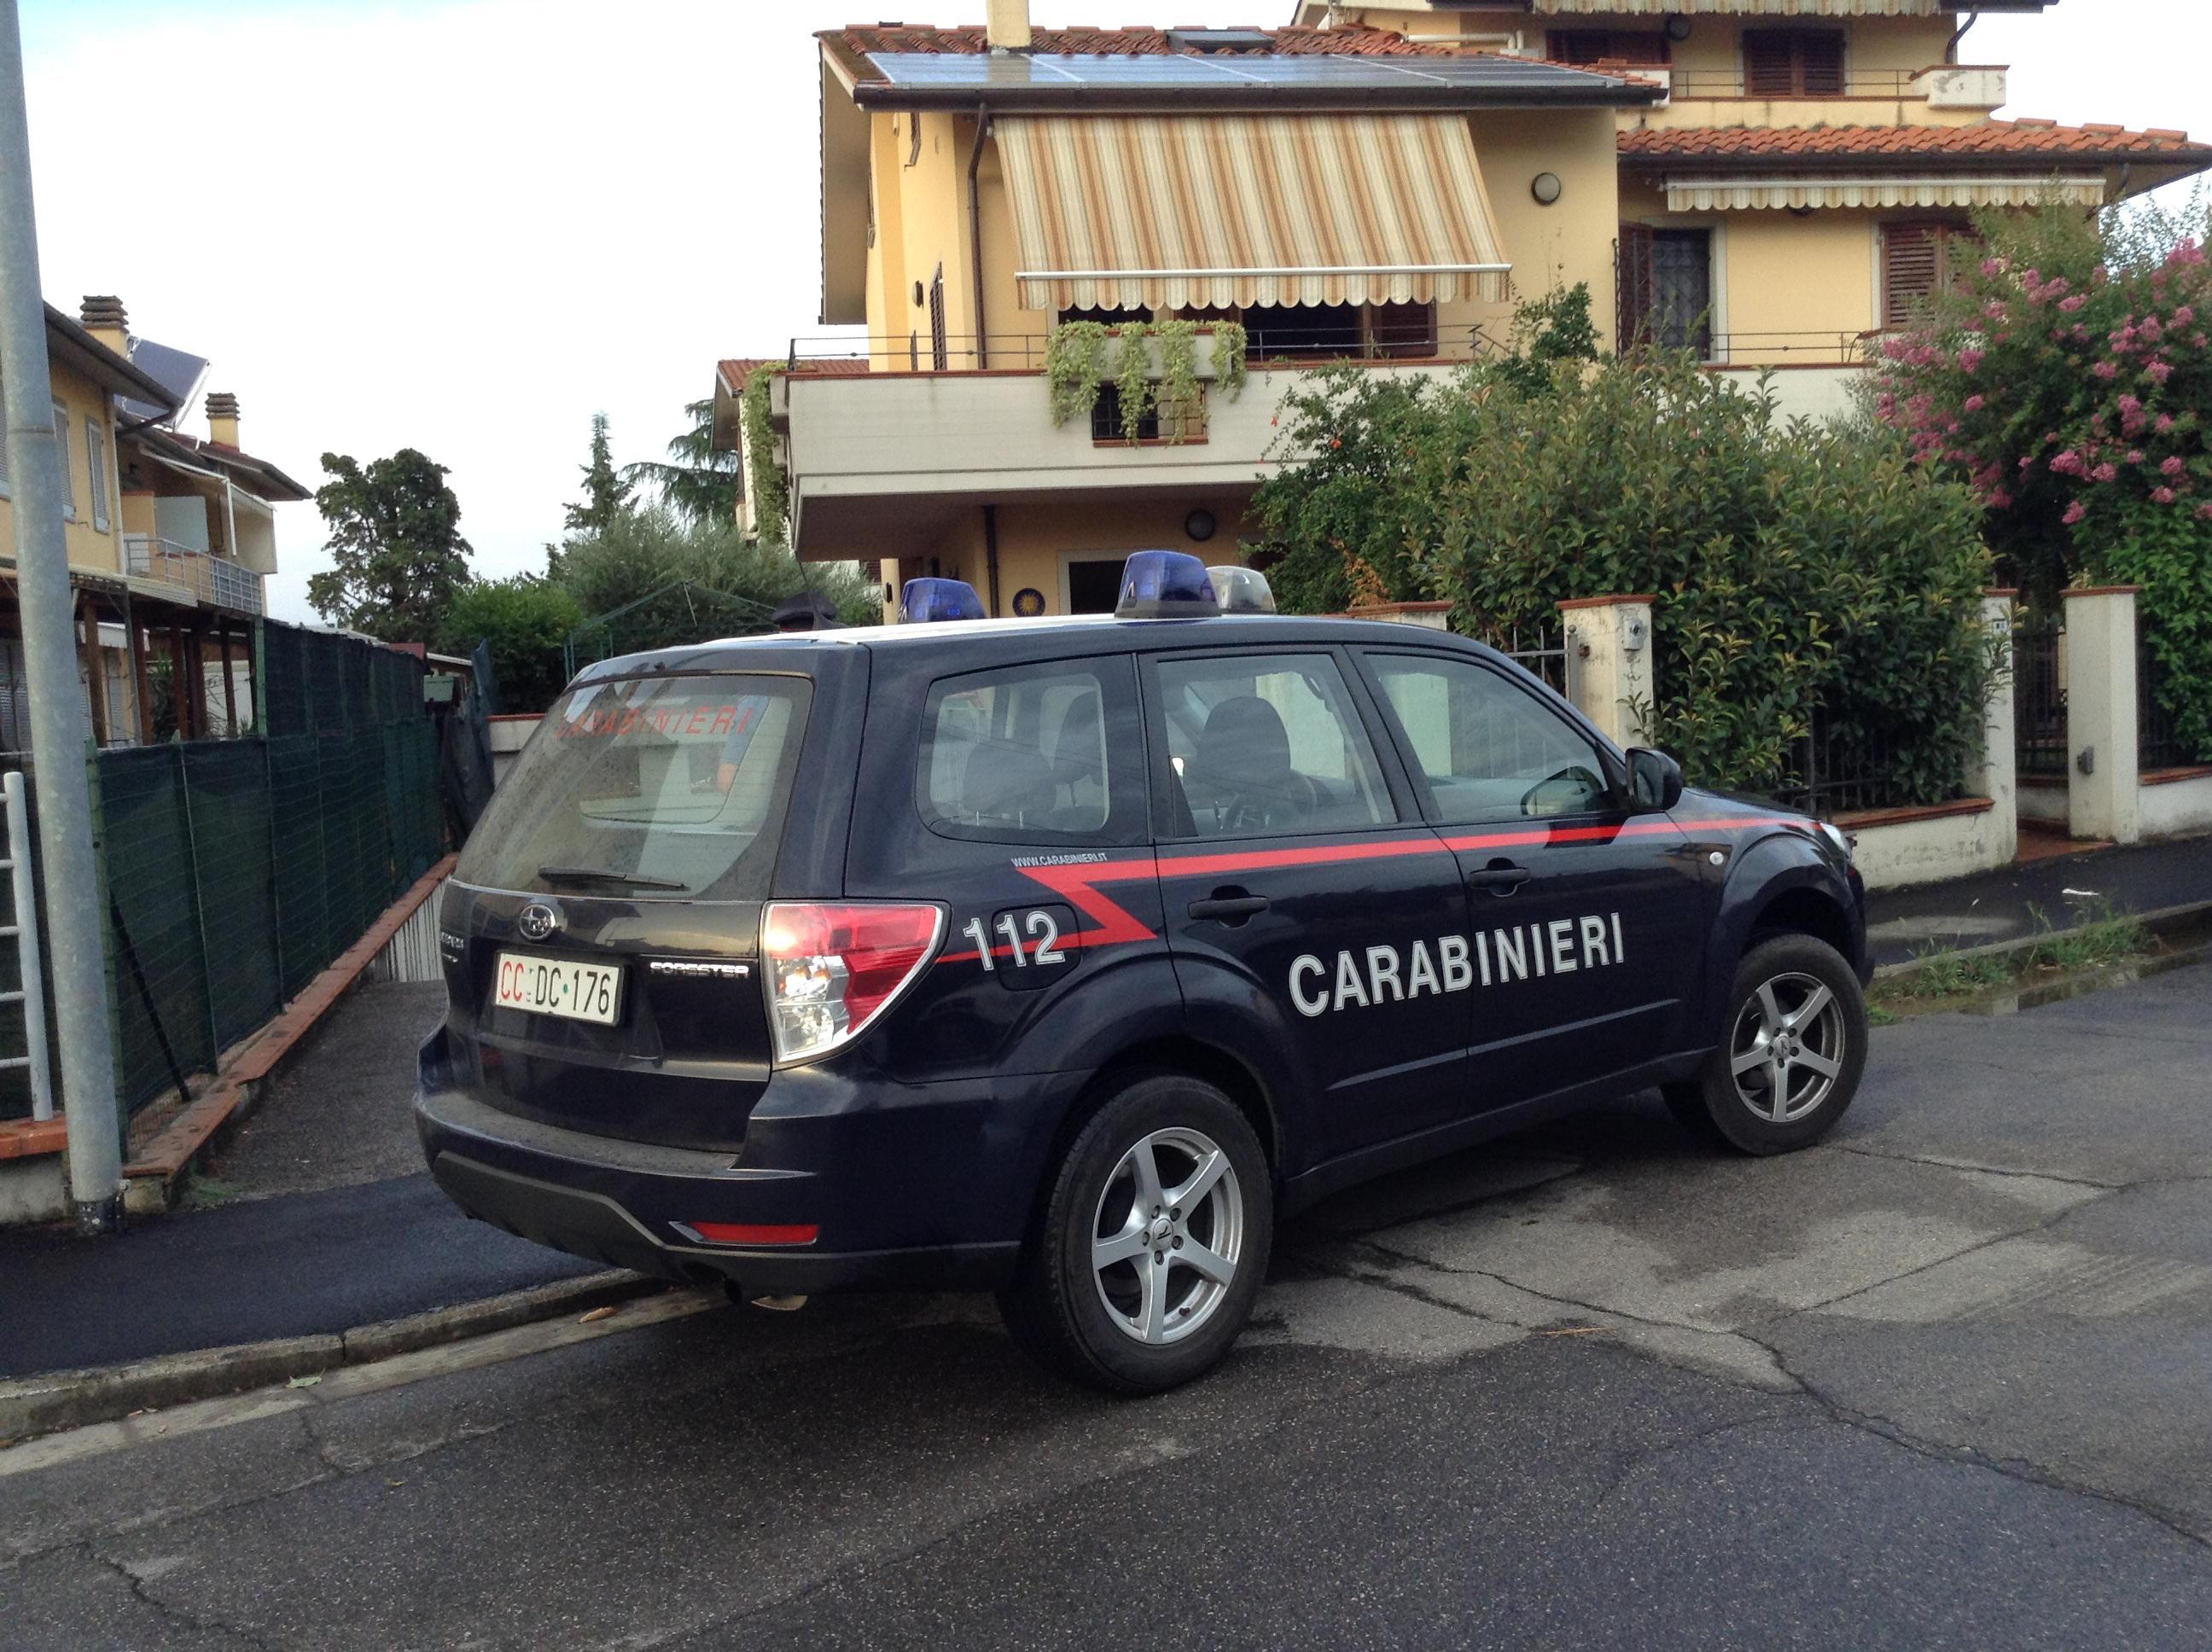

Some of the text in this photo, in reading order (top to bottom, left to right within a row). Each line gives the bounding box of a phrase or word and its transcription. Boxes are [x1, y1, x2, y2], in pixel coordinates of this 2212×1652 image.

[1011, 852, 1109, 867] WWW.CARABINIERI.IT
[963, 910, 1066, 971] 112
[650, 962, 748, 978] FORESTER
[1289, 912, 1624, 1017] CARABINIERI
[573, 969, 611, 1015] 176
